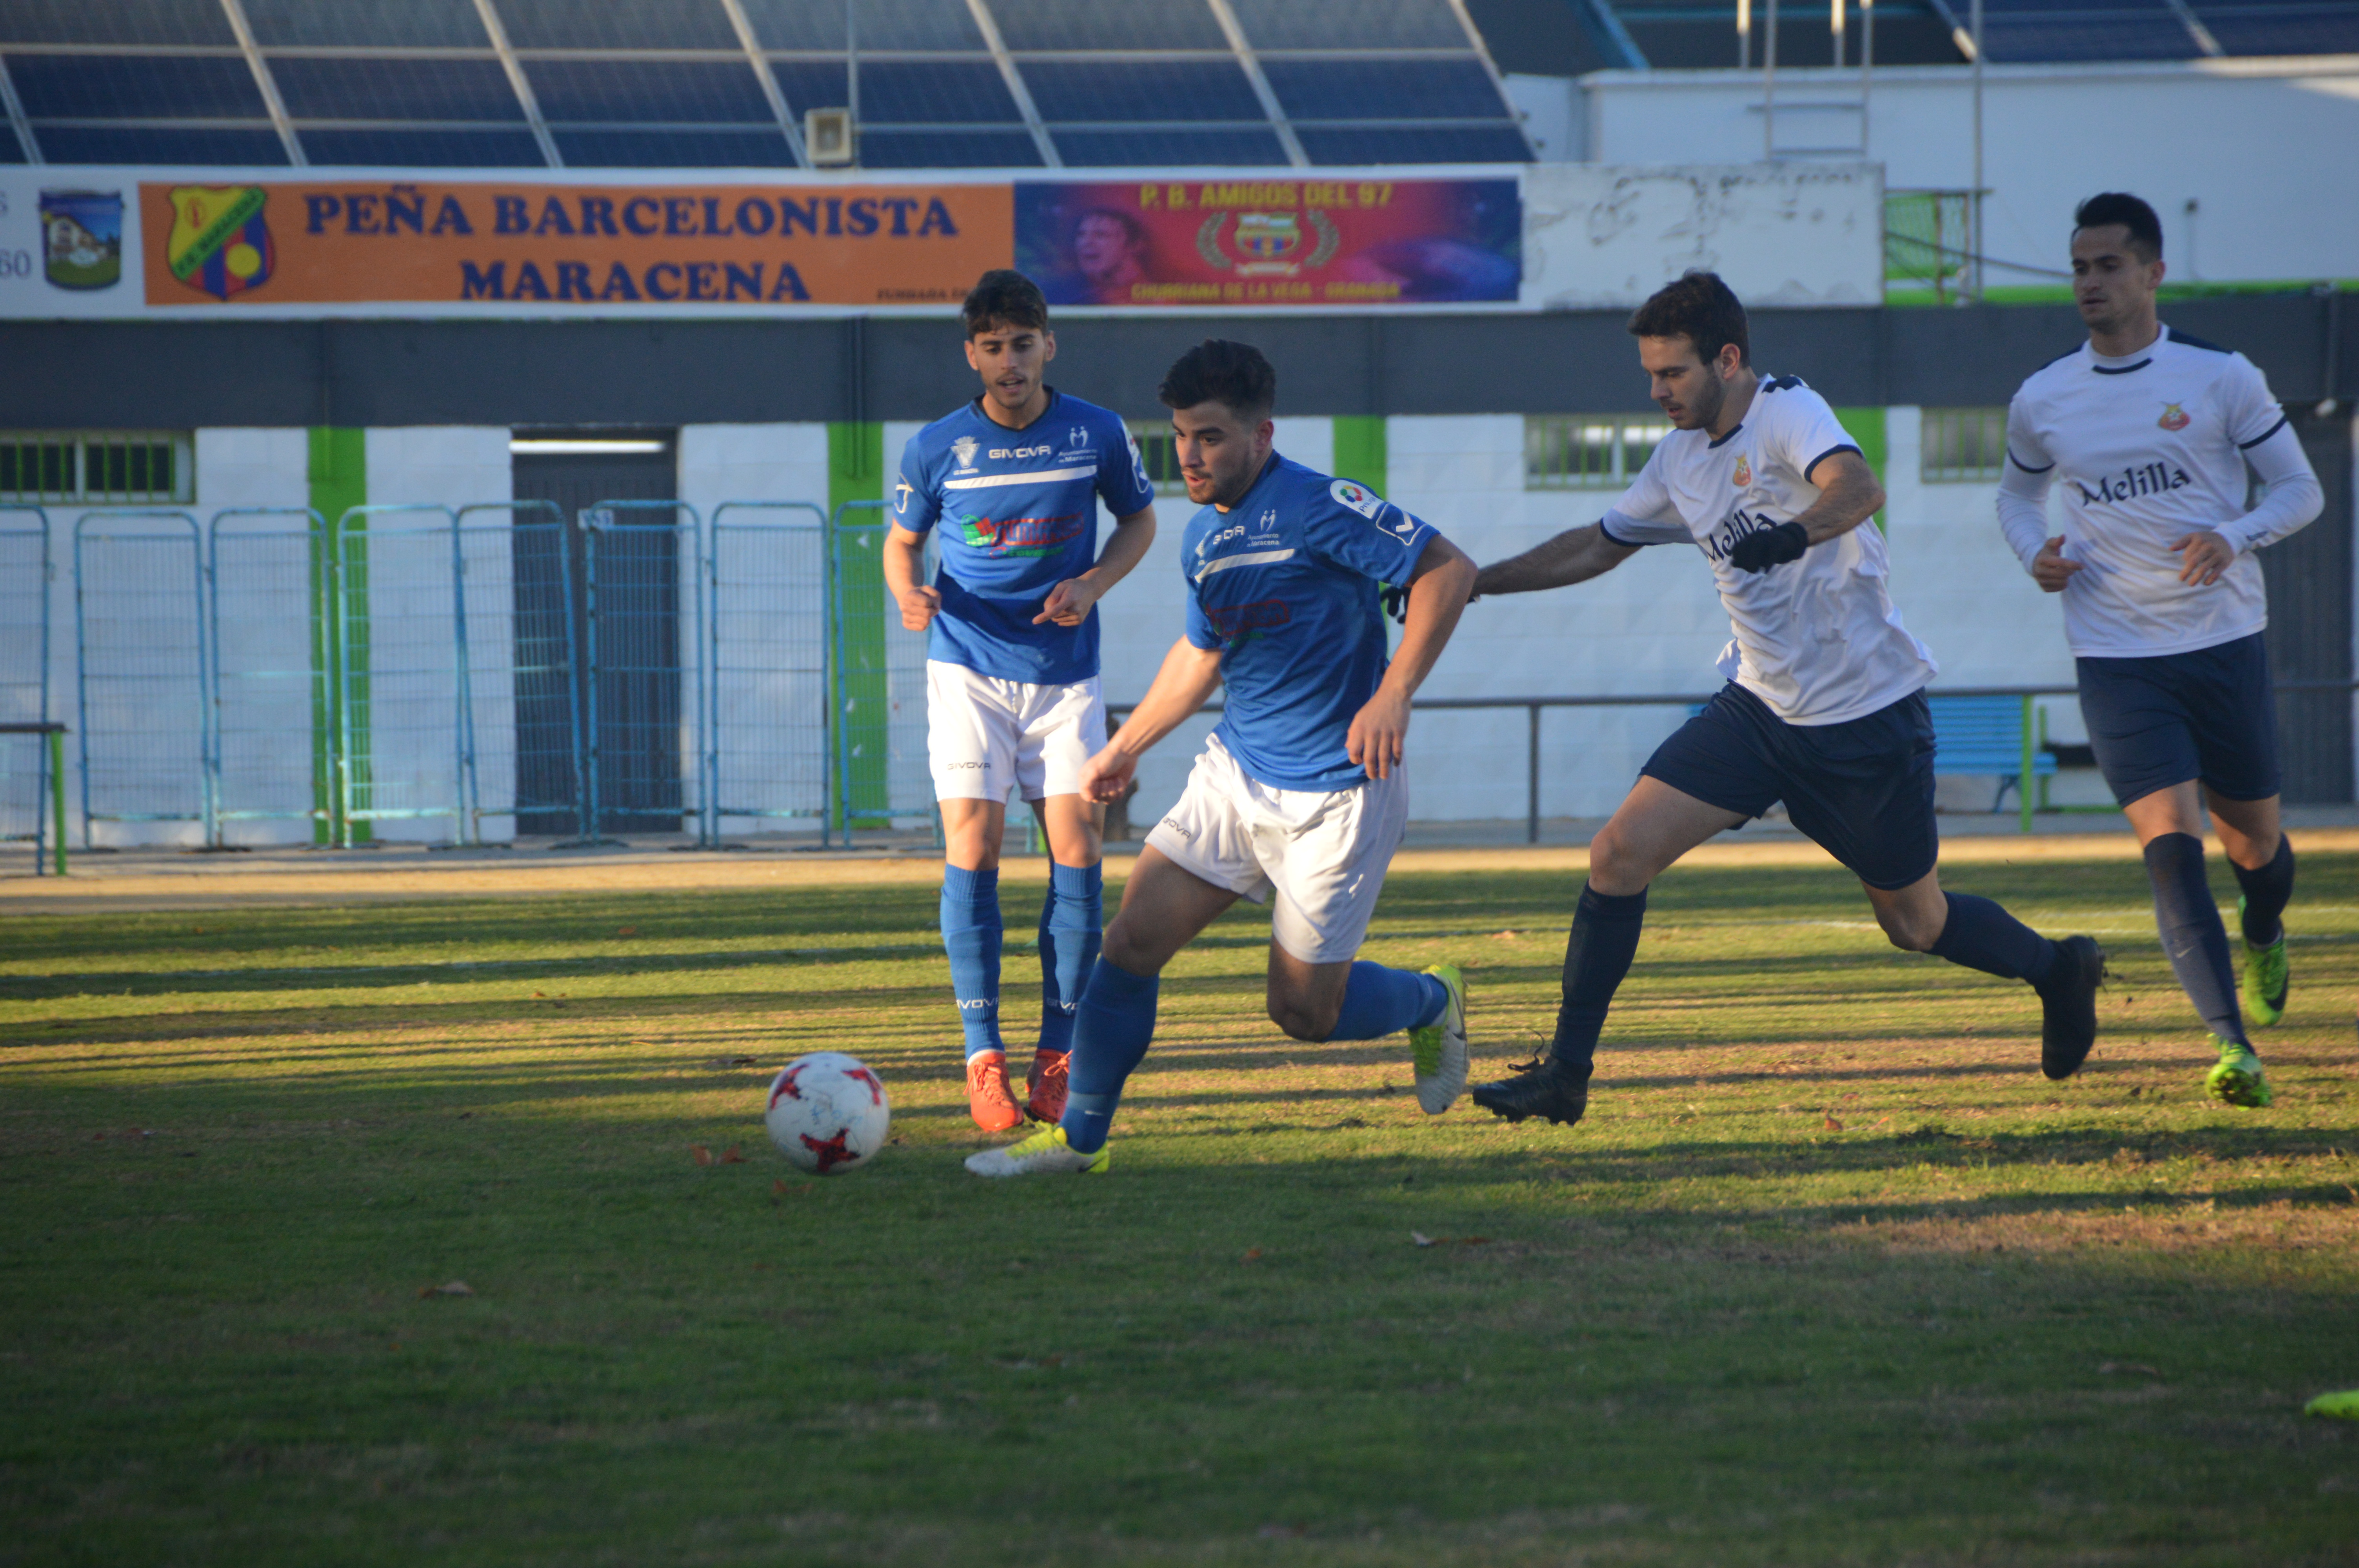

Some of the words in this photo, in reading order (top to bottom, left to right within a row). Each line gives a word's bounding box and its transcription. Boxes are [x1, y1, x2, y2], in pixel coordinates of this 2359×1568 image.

[303, 184, 475, 235] PEÑA
[492, 194, 959, 237] BARCELONISTA
[1199, 181, 1298, 208] AMIGOS
[1303, 181, 1352, 207] DEL
[459, 260, 812, 302] MARACENA
[988, 445, 1051, 459] GIVOVA
[2076, 461, 2192, 507] Melilla
[947, 761, 991, 770] GIVOVA
